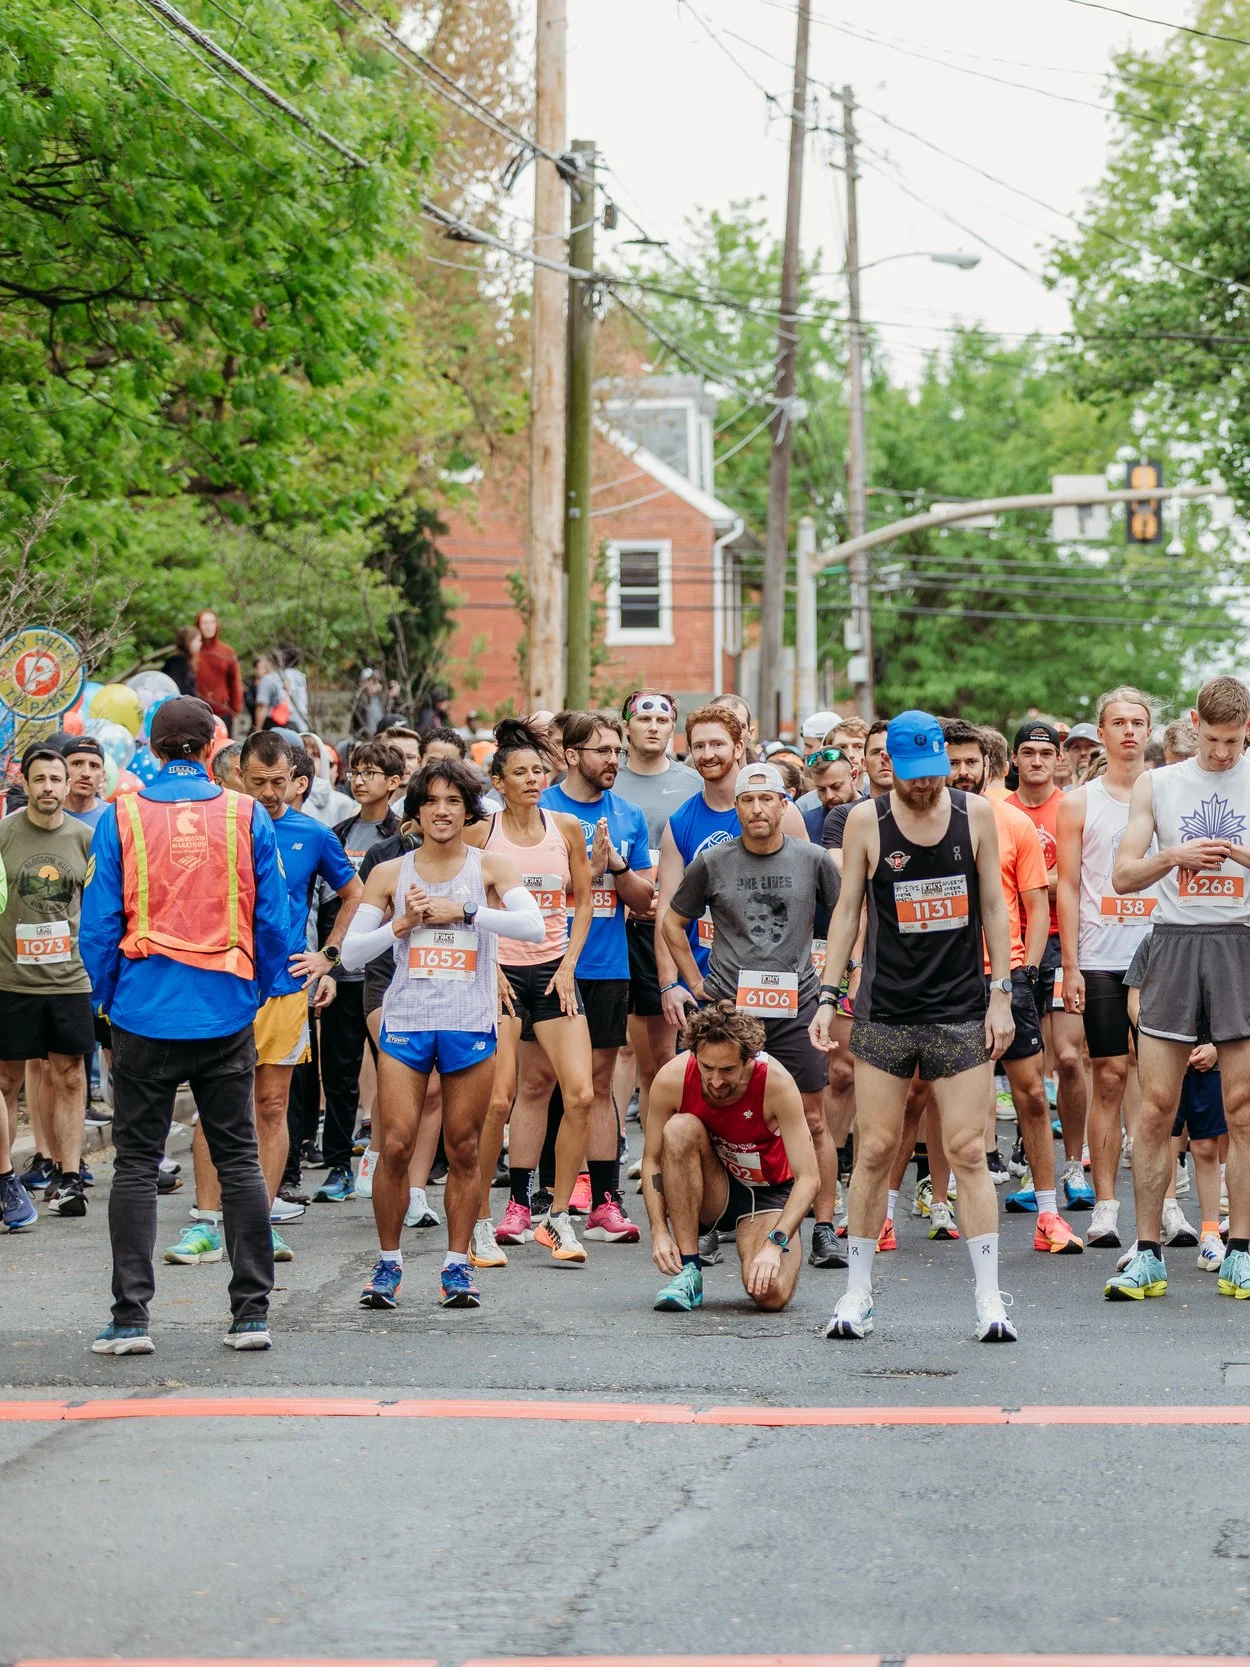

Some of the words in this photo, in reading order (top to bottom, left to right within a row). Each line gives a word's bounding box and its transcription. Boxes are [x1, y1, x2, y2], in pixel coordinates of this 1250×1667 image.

[24, 856, 56, 870] BLOSSOM
[57, 860, 72, 873] HILL
[1187, 879, 1235, 894] 6268
[913, 900, 953, 920] 1131
[1115, 899, 1145, 914] 138
[23, 938, 65, 955] 1073
[418, 949, 467, 968] 1652
[746, 990, 790, 1007] 6106
[725, 1161, 753, 1180] 02
